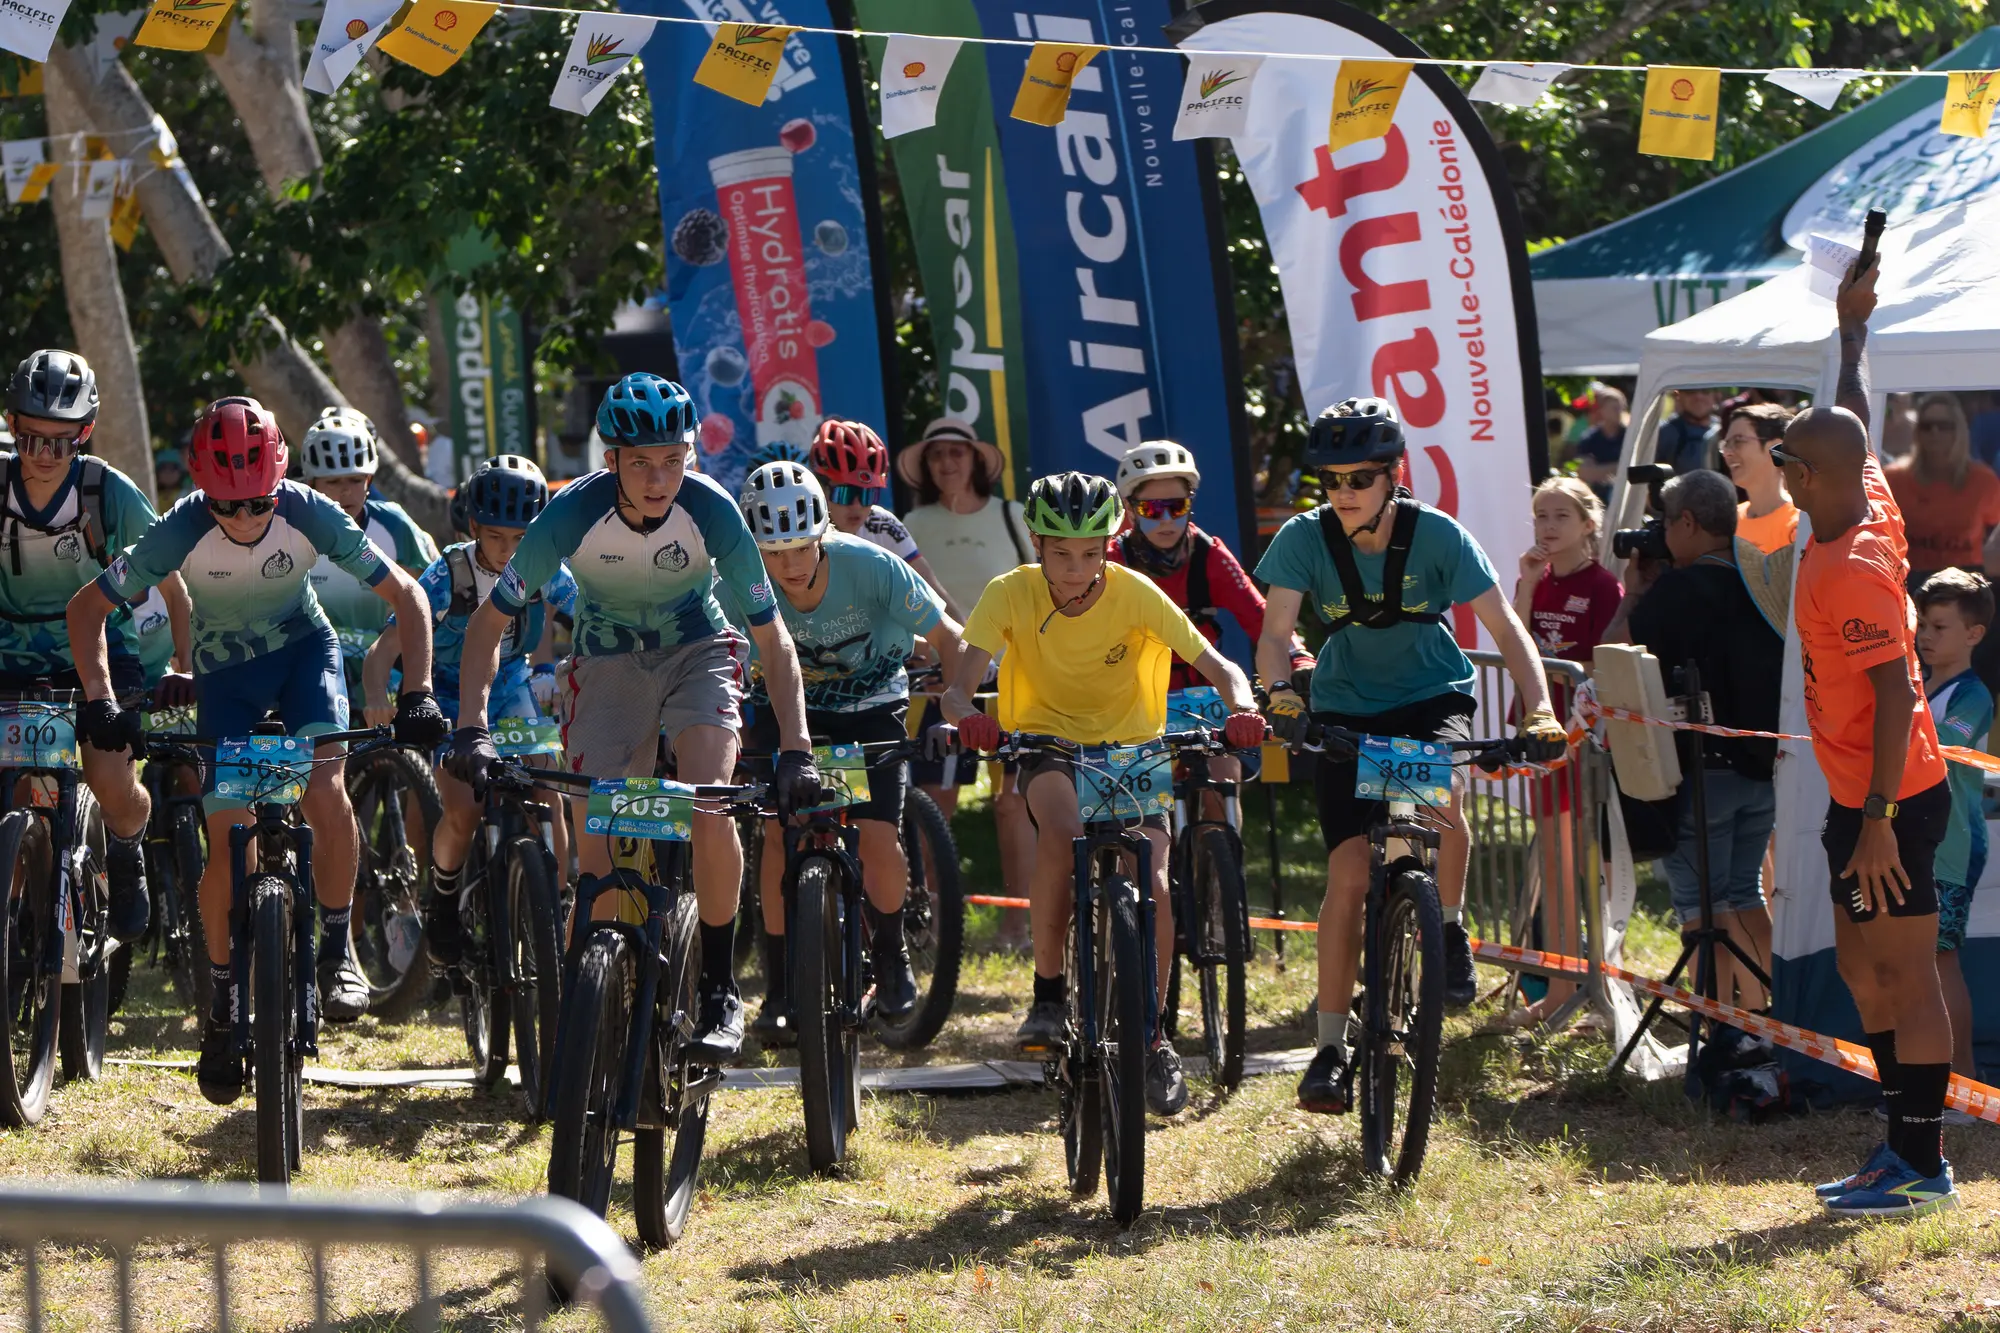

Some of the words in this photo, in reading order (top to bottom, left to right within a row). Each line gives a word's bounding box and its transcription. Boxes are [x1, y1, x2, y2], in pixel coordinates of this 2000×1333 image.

[2, 0, 55, 24] PACIFIC
[155, 9, 214, 27] PACIFIC
[405, 26, 441, 47] Distributeur
[442, 43, 459, 55] Shell
[760, 1, 811, 65] vore
[716, 42, 772, 71] PACIFIC
[1187, 96, 1243, 110] PACIFIC
[1336, 103, 1390, 120] PACIFIC
[730, 190, 752, 261] Optimise
[750, 185, 802, 359] Hydratis
[1429, 119, 1494, 441] Nouvelle-Calédonie
[600, 551, 625, 561] DIFFU
[821, 609, 867, 633] PACIFIC
[7, 724, 57, 746] 300
[252, 738, 278, 746] MEGA
[259, 743, 271, 751] 25
[491, 730, 537, 745] 601
[1393, 740, 1418, 750] MEGA
[238, 757, 291, 780] 305
[1379, 758, 1431, 783] 308
[1099, 771, 1152, 798] 306
[611, 794, 670, 818] 605
